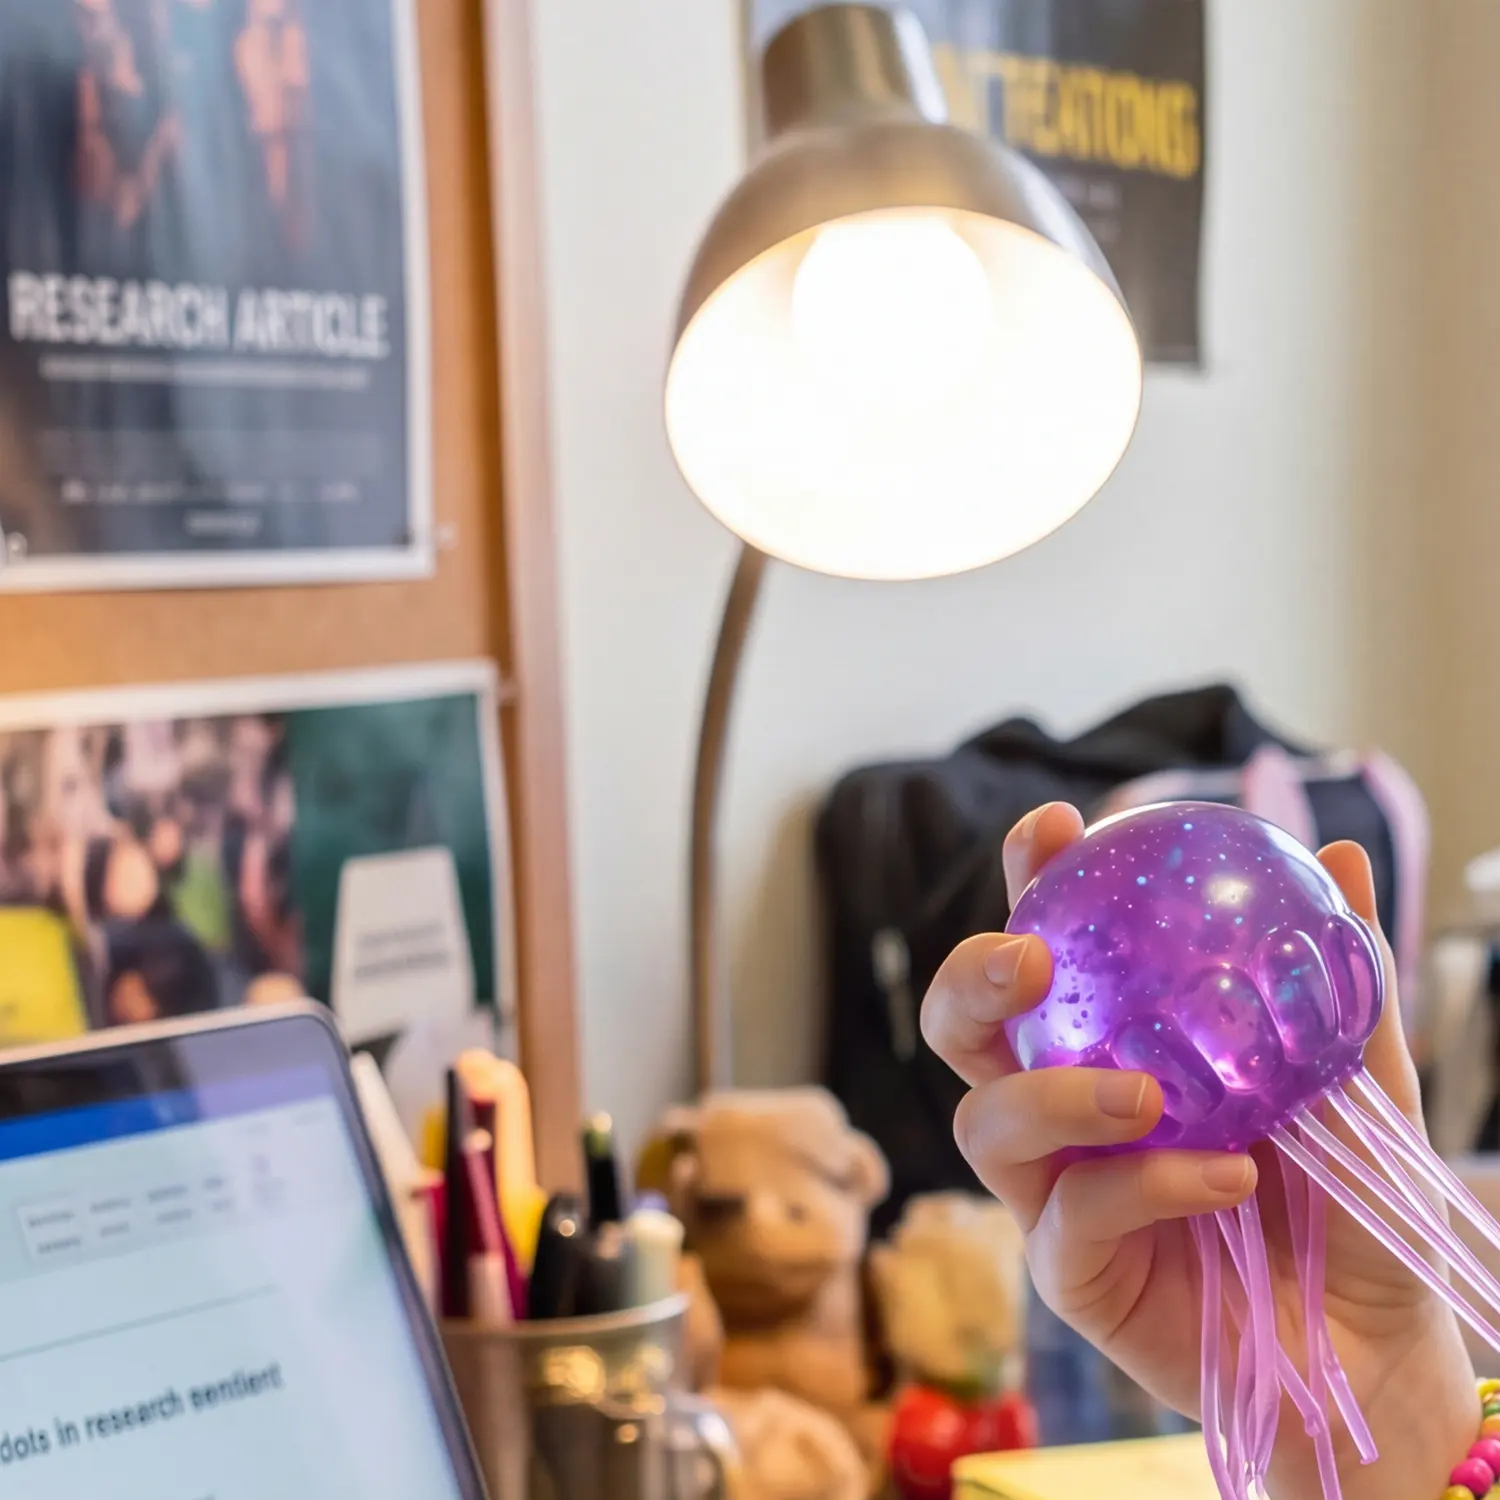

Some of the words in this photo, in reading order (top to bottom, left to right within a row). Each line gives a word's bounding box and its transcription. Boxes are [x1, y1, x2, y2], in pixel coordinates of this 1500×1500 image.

[8, 270, 227, 349] RESEARCH
[234, 286, 390, 359] ARTICLE
[54, 1417, 80, 1447] in
[85, 1387, 186, 1441] research
